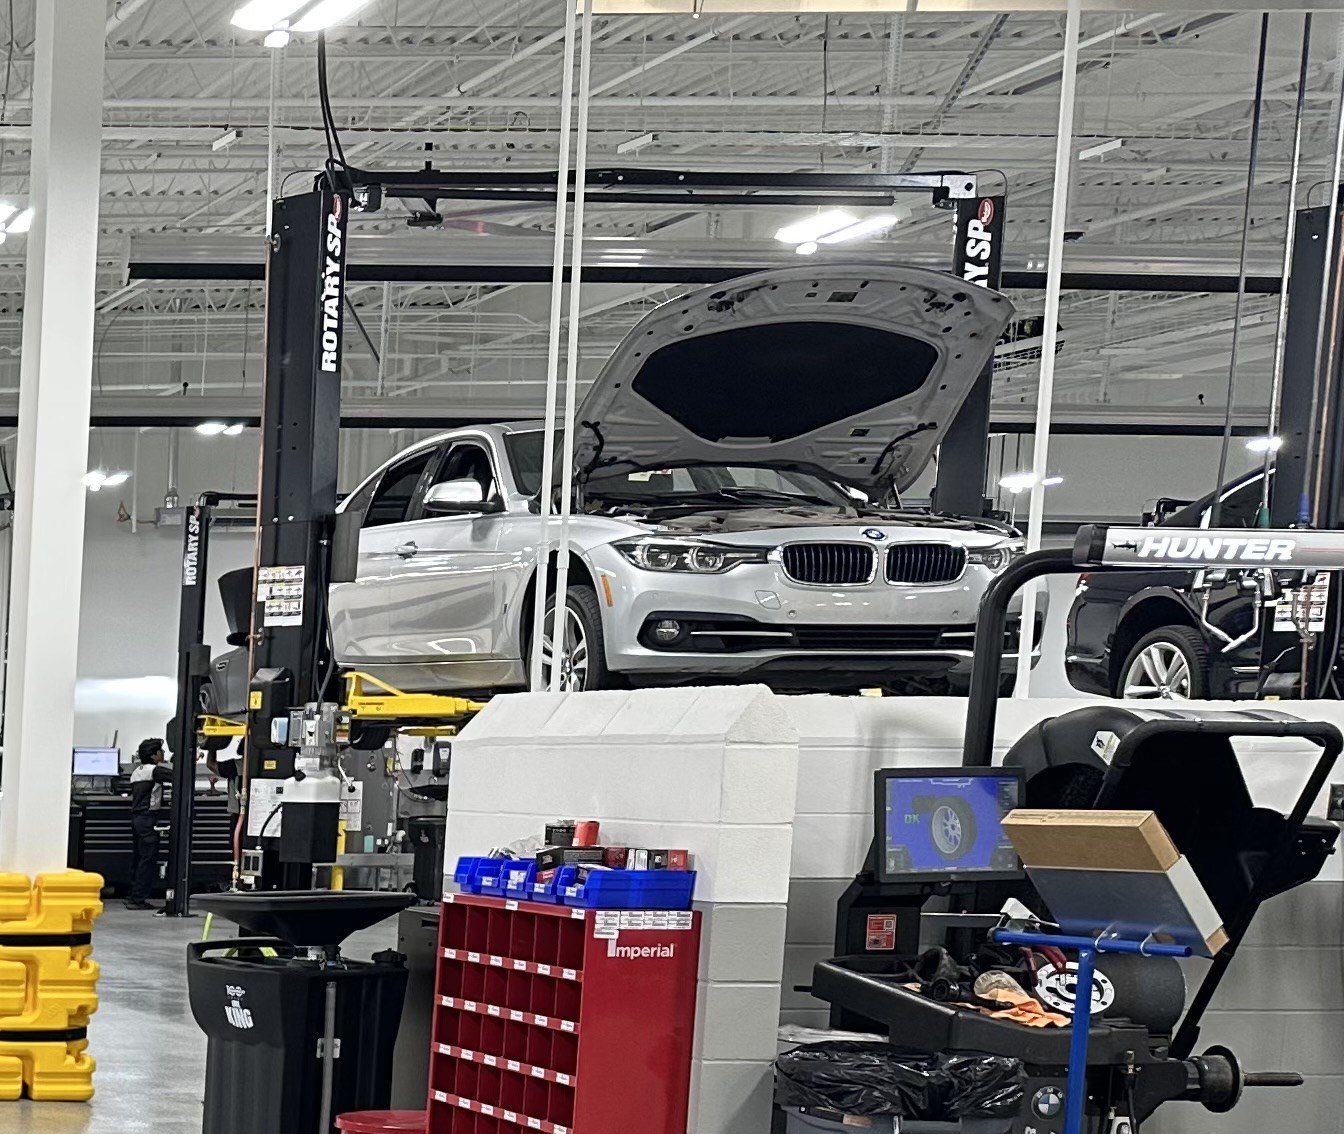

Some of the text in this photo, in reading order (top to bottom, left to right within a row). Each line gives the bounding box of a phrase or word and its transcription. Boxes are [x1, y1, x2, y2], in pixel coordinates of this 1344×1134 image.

[965, 218, 993, 260] SP
[321, 213, 342, 372] ROTARY SP
[185, 534, 200, 586] ROTARY
[1137, 536, 1297, 561] HUNTER
[606, 937, 675, 960] Imperial
